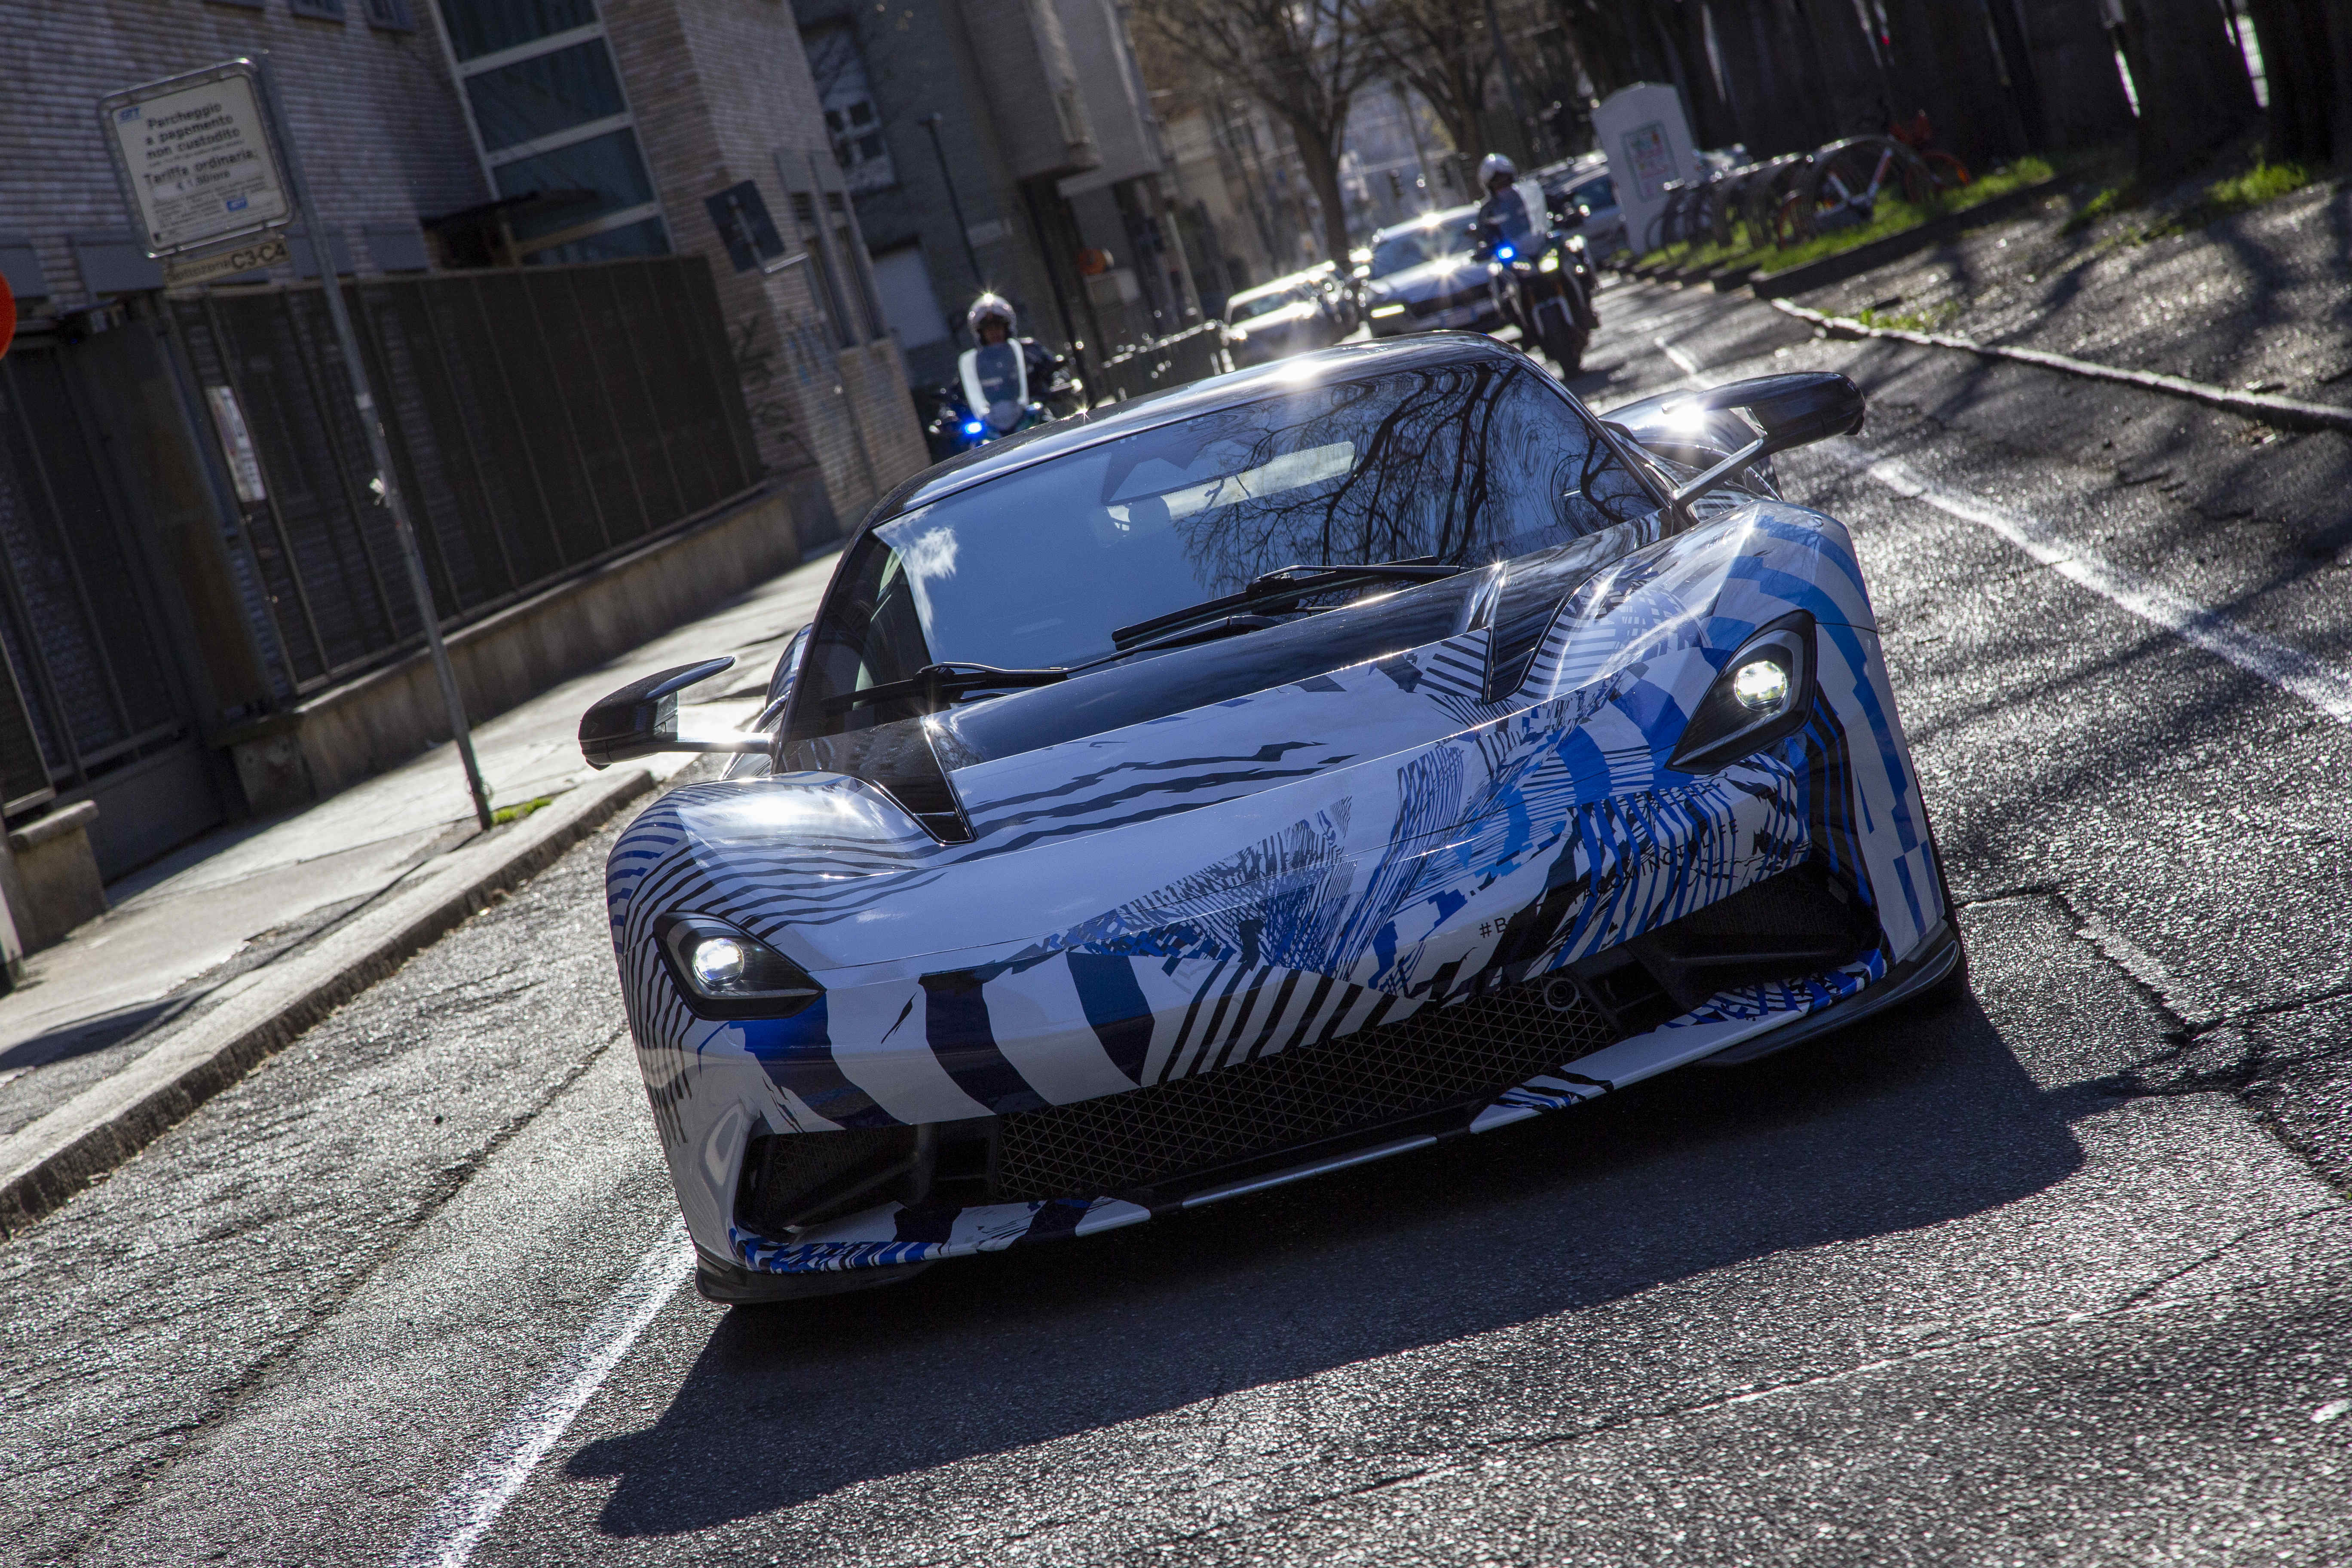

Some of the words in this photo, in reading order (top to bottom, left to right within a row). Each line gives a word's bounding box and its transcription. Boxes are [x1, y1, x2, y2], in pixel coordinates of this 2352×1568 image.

[146, 137, 153, 145] a
[159, 114, 234, 143] pagamento
[147, 103, 221, 129] Parcheggio
[146, 147, 172, 159] non
[178, 129, 241, 152] custodito
[144, 166, 189, 185] Tariffa
